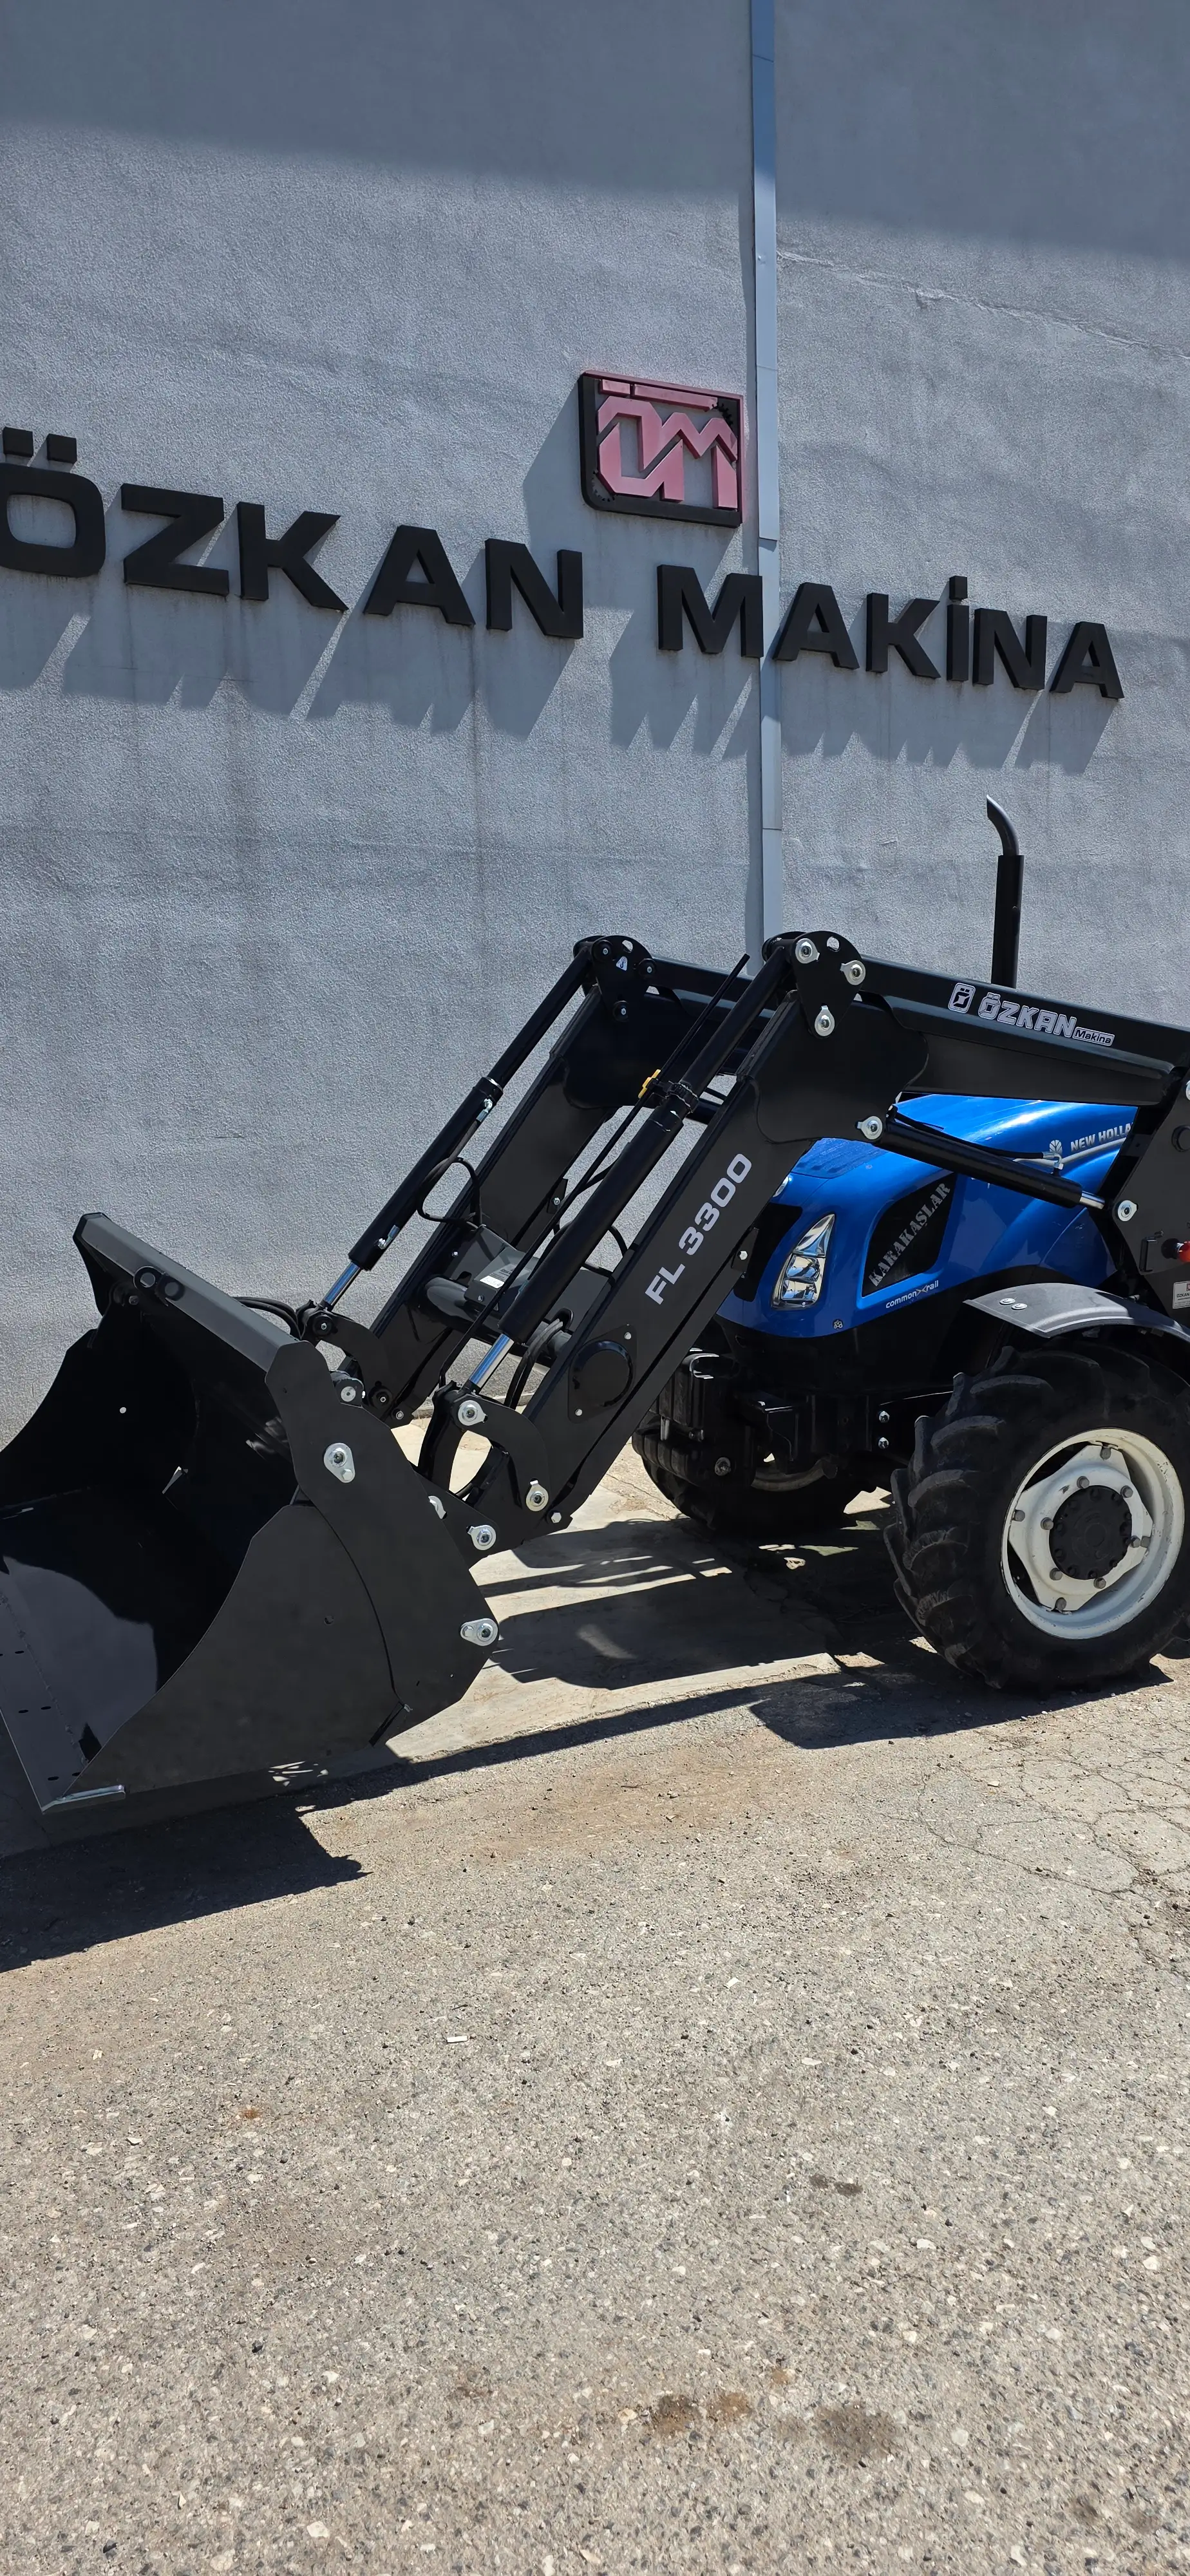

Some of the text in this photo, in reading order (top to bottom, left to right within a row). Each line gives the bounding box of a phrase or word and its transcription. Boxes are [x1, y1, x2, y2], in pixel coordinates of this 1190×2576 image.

[0, 426, 1125, 700] ÖZKAN MAKİNA
[978, 992, 1111, 1044] ÖZKAN Makina
[1070, 1122, 1133, 1152] NEW HOLLA
[645, 1153, 752, 1305] FL 3300
